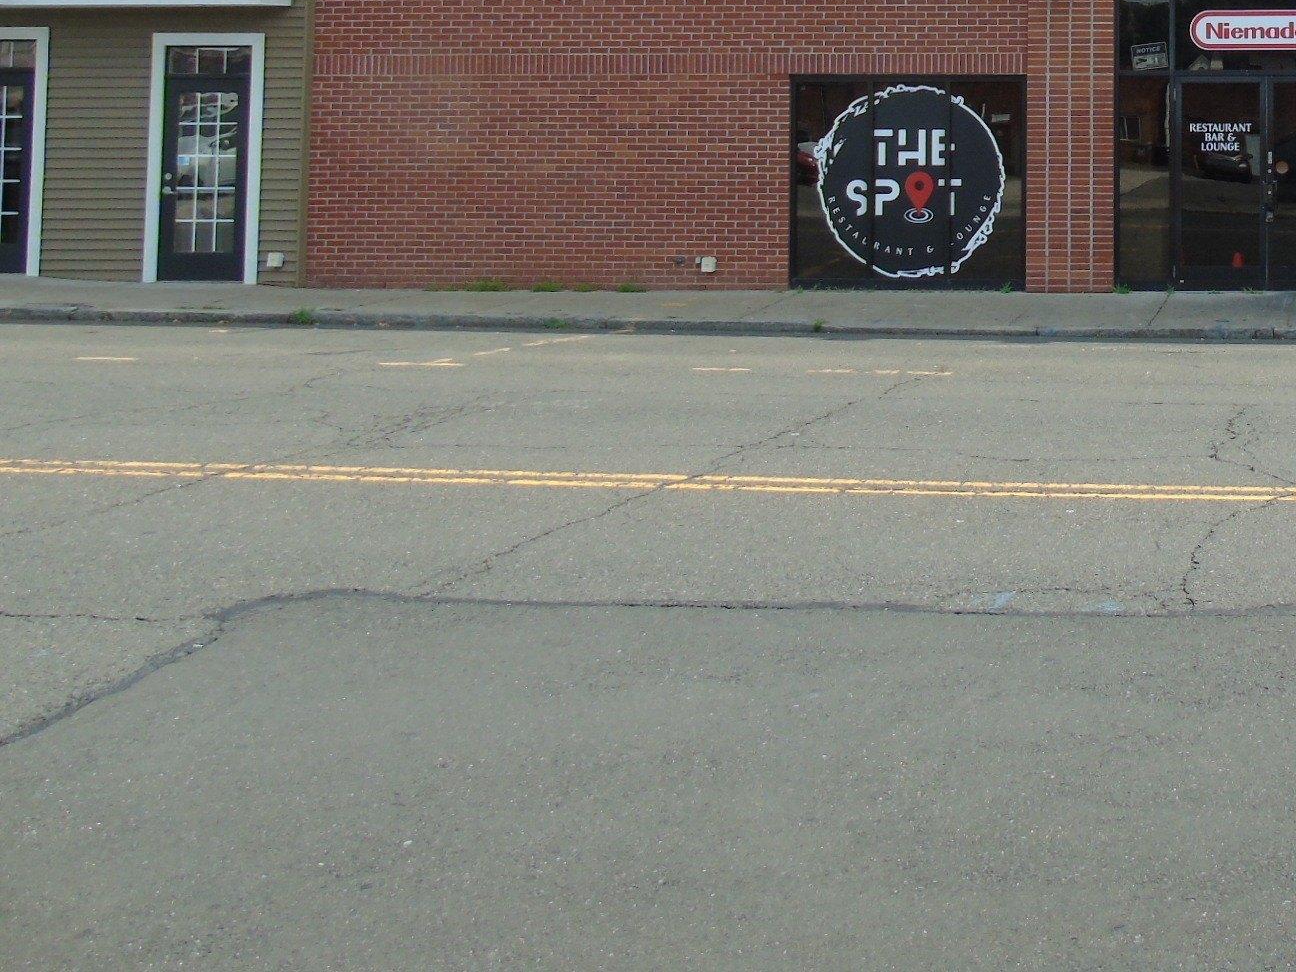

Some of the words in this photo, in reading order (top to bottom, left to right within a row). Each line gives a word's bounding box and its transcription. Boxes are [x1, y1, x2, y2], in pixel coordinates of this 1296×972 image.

[1136, 45, 1161, 54] NOTICE
[1190, 123, 1252, 132] RESTAURANT
[1205, 133, 1224, 141] BAR
[1227, 133, 1236, 141] &
[874, 129, 955, 166] THE
[1201, 143, 1240, 151] LOUNGE
[926, 245, 935, 253] &
[950, 195, 991, 246] OUNGE
